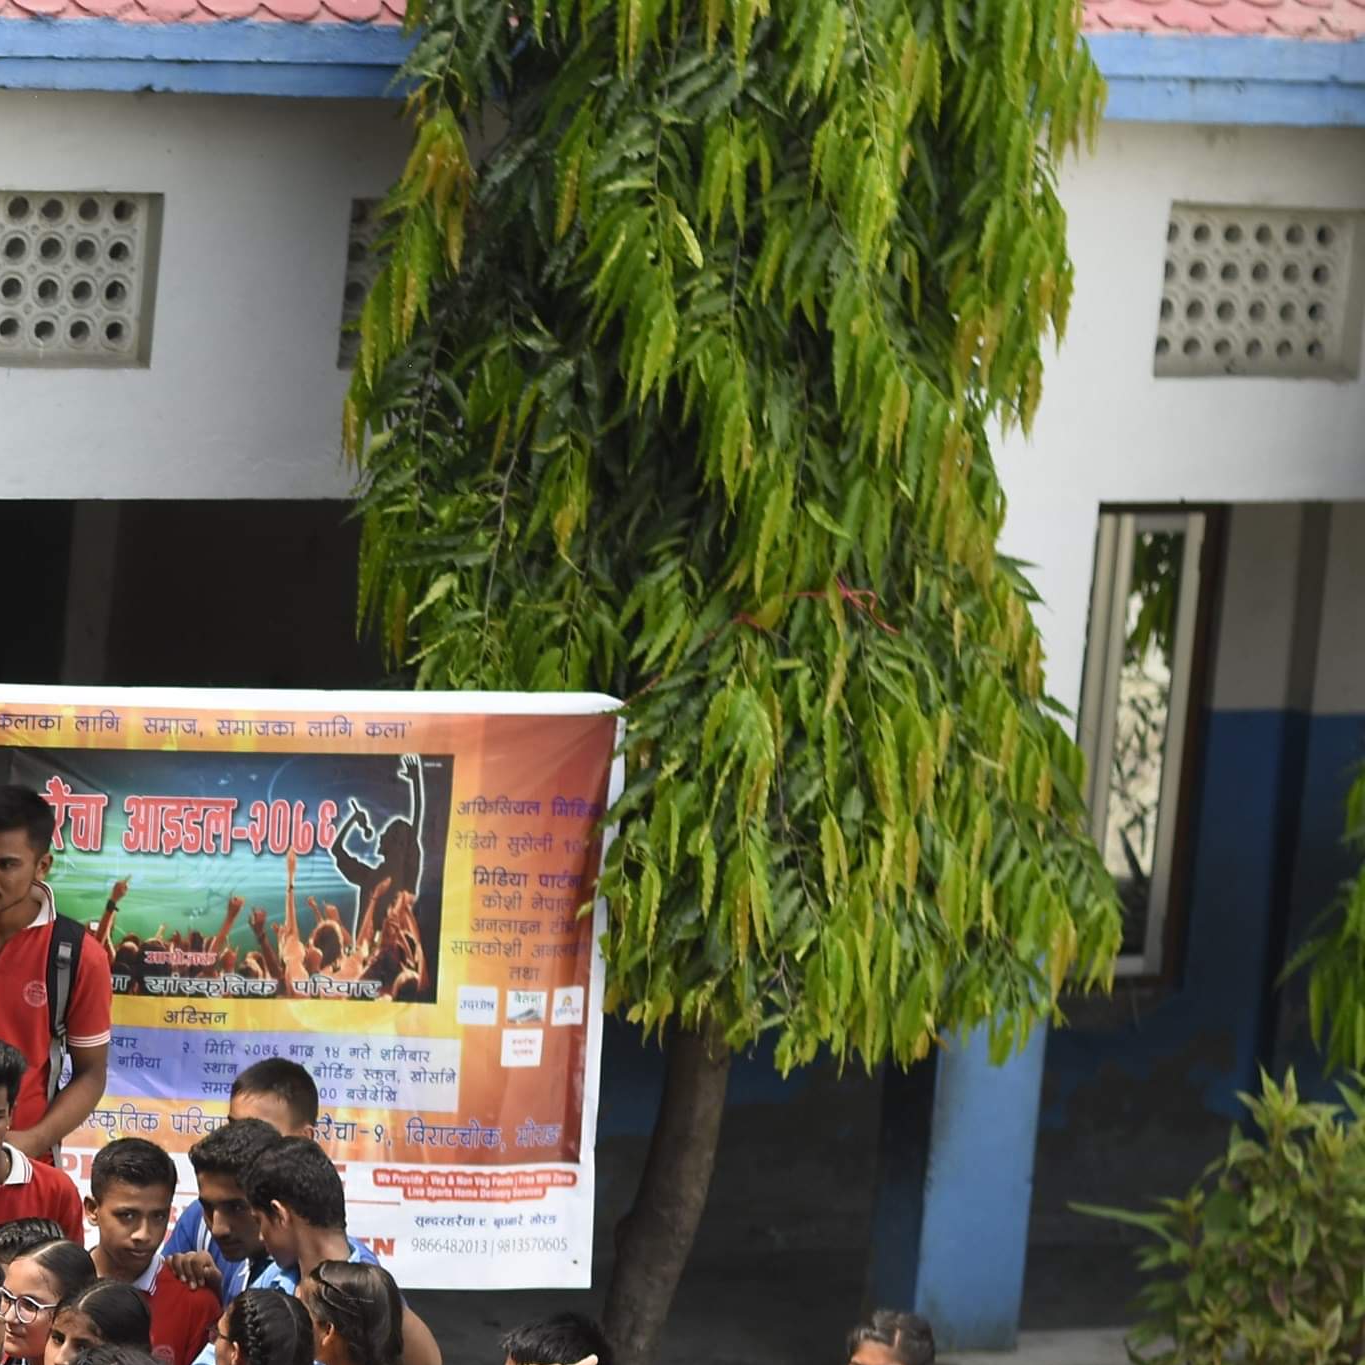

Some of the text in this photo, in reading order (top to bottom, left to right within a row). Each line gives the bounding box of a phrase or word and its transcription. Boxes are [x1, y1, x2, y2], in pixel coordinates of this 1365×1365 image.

[74, 712, 120, 732] लागि
[143, 716, 204, 738] समाज,
[217, 719, 294, 737] समाजका
[308, 716, 353, 738] लागि
[474, 866, 528, 886] मिडिया
[483, 891, 522, 911] कोशी
[509, 966, 540, 981] तथा
[145, 973, 278, 998] सांस्कृतिक
[292, 974, 383, 998] परिवार
[163, 1007, 229, 1025] अडिसन
[204, 1038, 235, 1055] मिति
[349, 1043, 372, 1060] गते
[381, 1045, 430, 1062] शनिबार
[203, 1062, 238, 1075] स्थान
